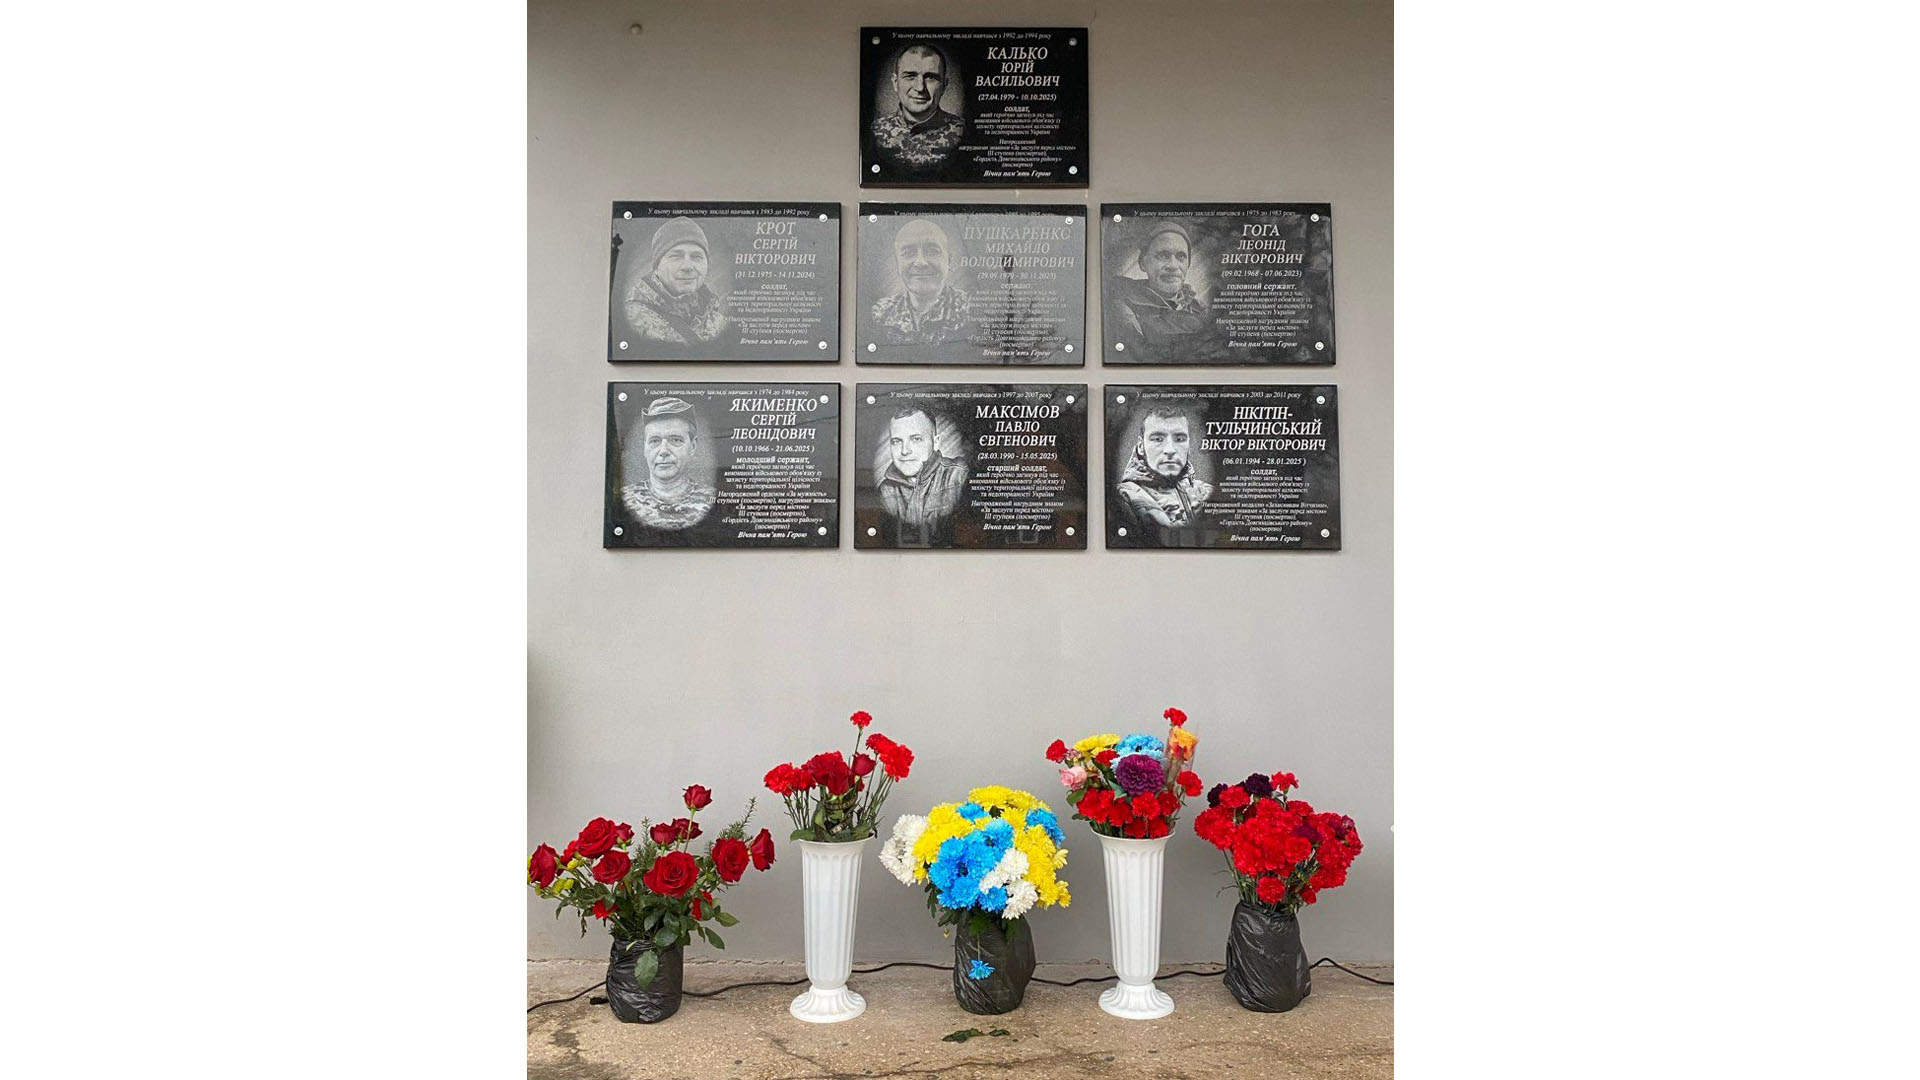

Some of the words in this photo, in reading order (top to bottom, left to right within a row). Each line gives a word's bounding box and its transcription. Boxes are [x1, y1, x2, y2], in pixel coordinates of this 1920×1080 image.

[988, 47, 1048, 60] КАЛЬКО
[1001, 60, 1034, 73] ЮРІЙ
[975, 76, 1060, 87] ВАСИЛЬОВИЧ
[1021, 94, 1057, 102] 10.10.2025)
[756, 221, 796, 235] КРОТ
[963, 226, 1071, 240] ПУШКАРЕНКО
[1242, 224, 1280, 237] ГОГА
[753, 236, 798, 250] СЕРГІЙ
[985, 240, 1050, 254] МИХАЙЛО
[1237, 240, 1286, 252] ЛЕОНІД
[735, 254, 817, 265] ВІКТОРОВИЧ
[960, 256, 1075, 268] ВОЛОДИМИРОВИЧ
[1221, 253, 1304, 264] ВІКТОРОВИЧ
[729, 398, 818, 412] ЯКИМЕНКО
[976, 405, 1060, 419] МАКСІМОВ
[1233, 406, 1293, 420] НІКІТІН-
[751, 412, 797, 426] СЕРГІЙ
[995, 421, 1040, 433] ПАВЛО
[1206, 419, 1322, 436] ТУЛЬЧИНСЬКИЙ
[731, 428, 816, 441] ЛЕОНІДОВИЧ
[979, 435, 1056, 447] ЄВГЕНОВИЧ
[1201, 439, 1245, 451] ВІКТОР
[1248, 439, 1326, 451] ВІКТОРОВИЧ
[732, 445, 769, 453] (10.10.1966
[977, 452, 1015, 460] (28.03.1990
[1020, 452, 1058, 460] 15.05.2025)
[1222, 457, 1260, 466] (06.01.1994
[987, 464, 1019, 473] старший
